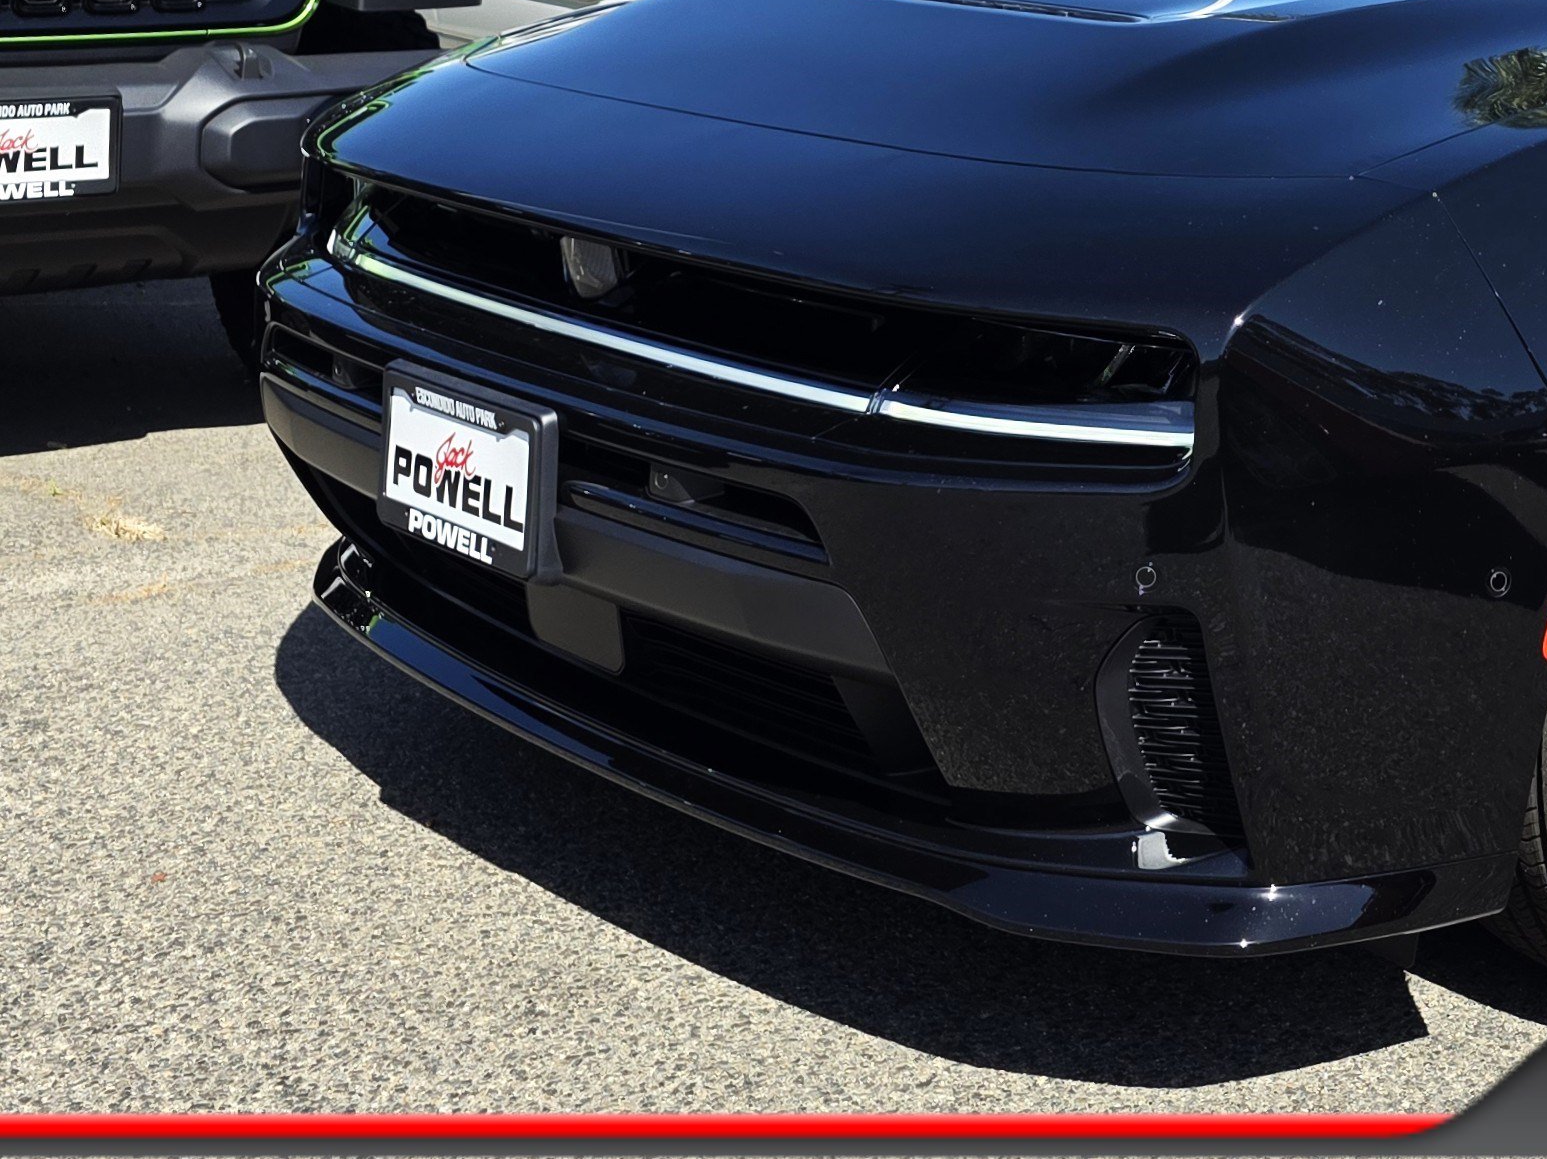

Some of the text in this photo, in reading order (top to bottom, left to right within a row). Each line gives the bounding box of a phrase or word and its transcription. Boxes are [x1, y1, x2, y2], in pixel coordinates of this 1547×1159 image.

[17, 104, 43, 117] AUTO
[44, 102, 71, 115] PARK
[455, 400, 476, 424] AUTO
[475, 407, 498, 430] PARK
[435, 432, 476, 484] Jack
[393, 445, 524, 533] POWELL
[408, 508, 493, 565] POWELL
